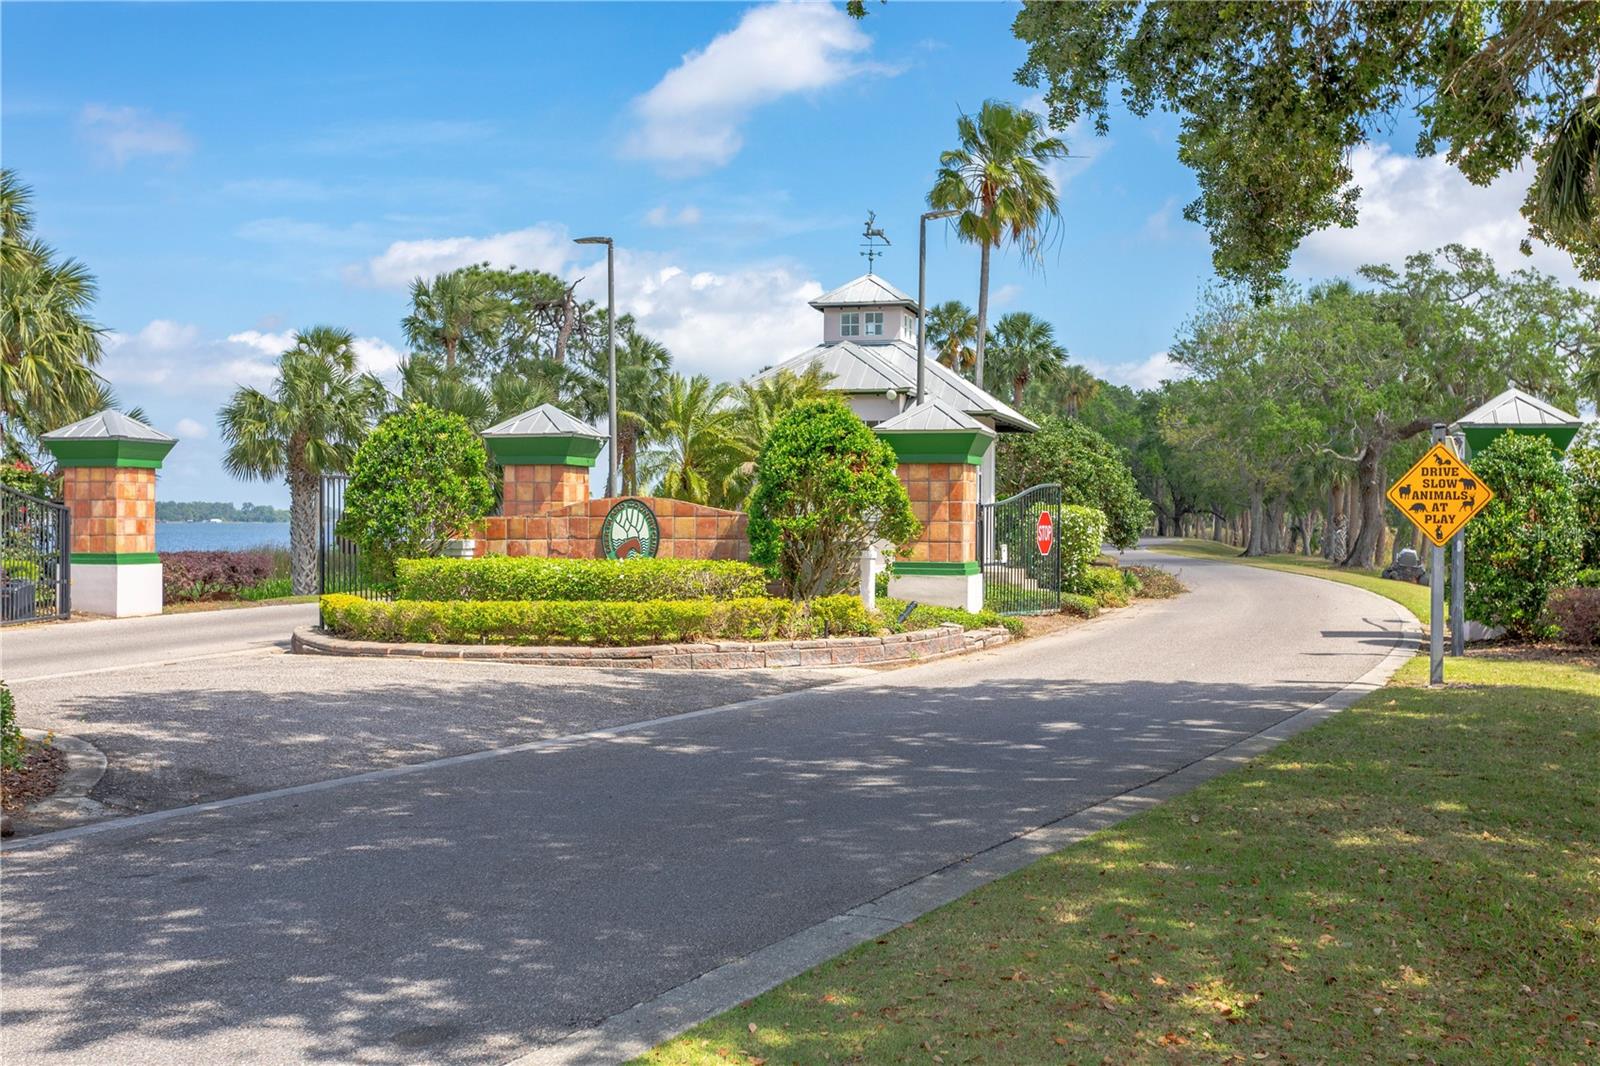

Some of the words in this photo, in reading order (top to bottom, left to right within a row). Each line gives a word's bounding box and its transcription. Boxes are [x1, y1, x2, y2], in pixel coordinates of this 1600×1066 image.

[1421, 467, 1459, 477] DRIVE
[1422, 478, 1458, 488] SLOW
[1412, 490, 1468, 500] ANIMALS
[1431, 502, 1449, 512] AT
[1424, 514, 1456, 524] PLAY
[1038, 525, 1052, 541] STOP
